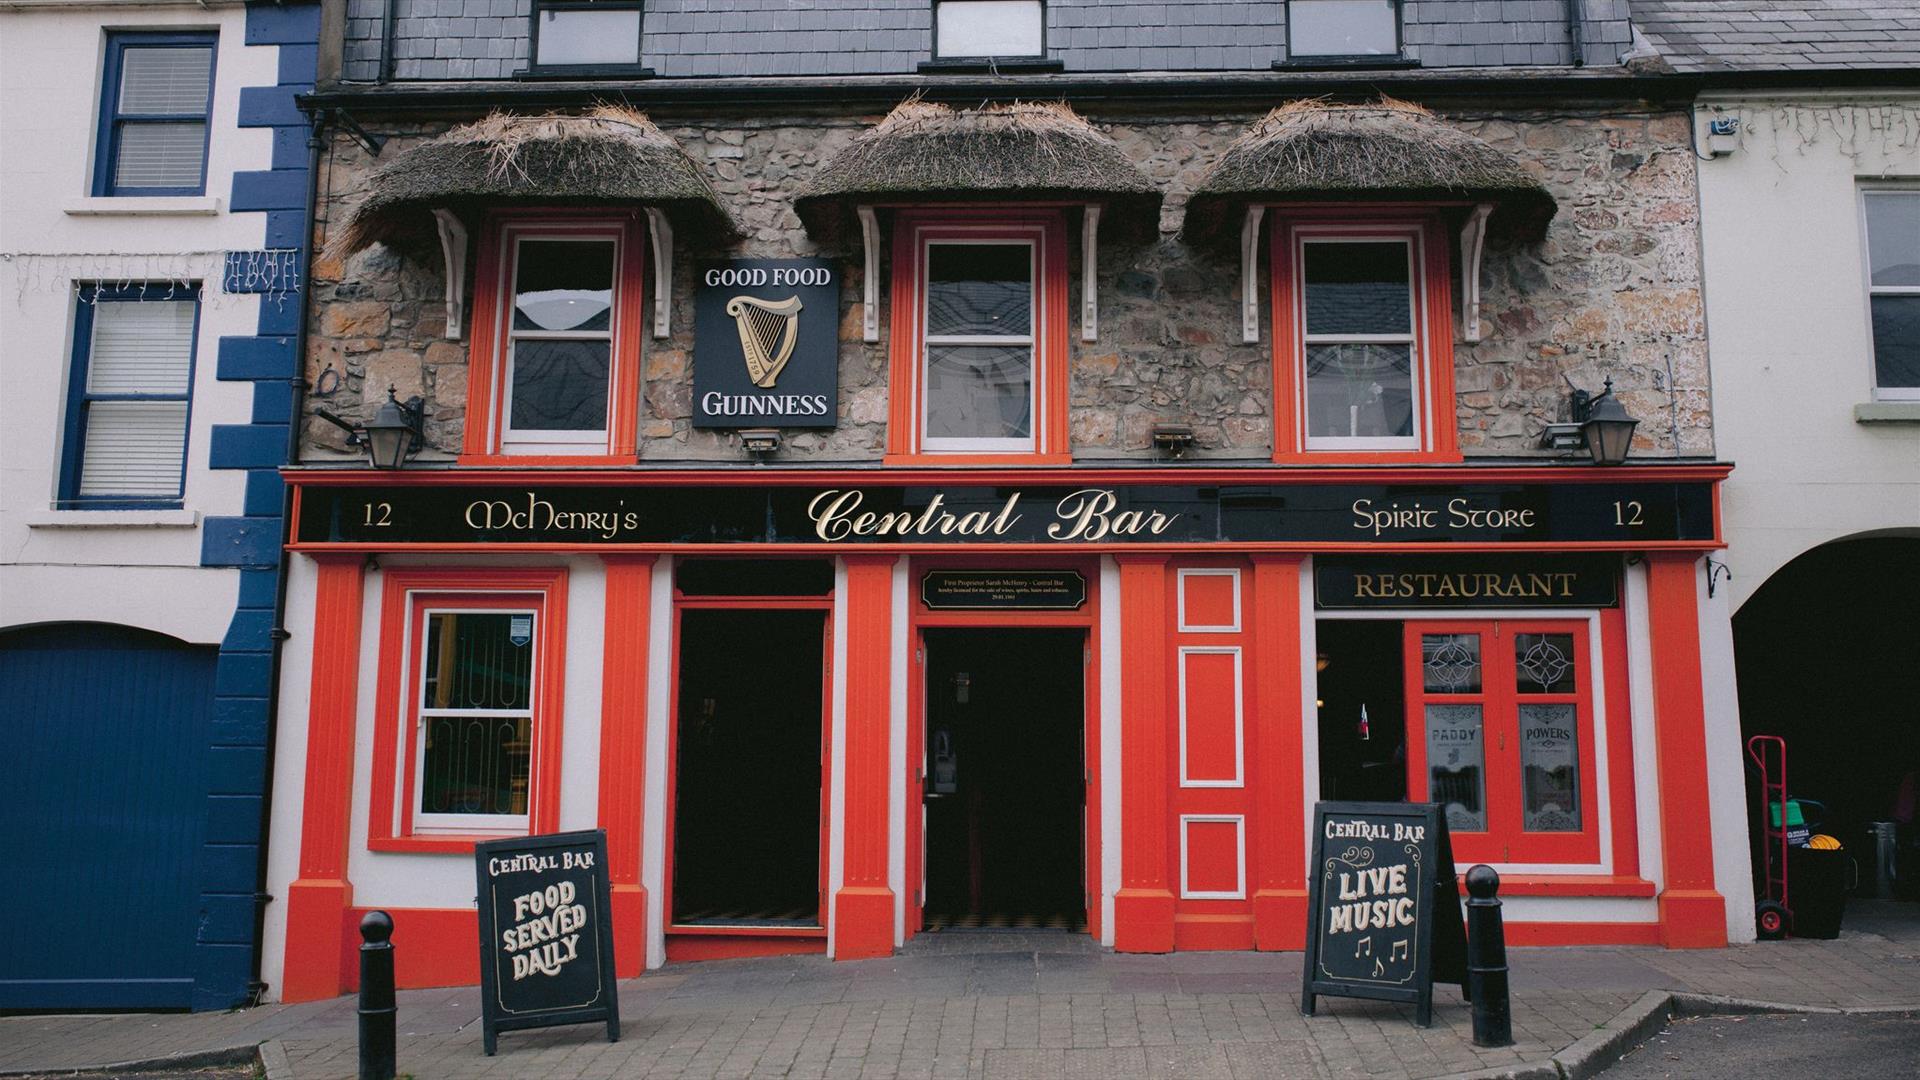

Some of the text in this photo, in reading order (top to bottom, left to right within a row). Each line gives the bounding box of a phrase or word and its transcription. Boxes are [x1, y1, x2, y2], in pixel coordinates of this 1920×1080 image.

[705, 268, 831, 286] GOOD FOOD
[702, 391, 828, 416] GUINNESS
[364, 502, 392, 527] 12
[465, 492, 638, 539] McHenry's
[807, 489, 1180, 542] Central Bar
[1352, 498, 1536, 536] Spirit Store
[1614, 501, 1644, 526] 12
[1354, 573, 1577, 598] RESTAURANT
[1432, 729, 1476, 741] PADDY
[1526, 727, 1570, 741] POWERS
[1325, 819, 1425, 843] CENTRAL BAR
[489, 851, 595, 877] CENTRAL BAR
[1338, 864, 1408, 900] LIVE
[513, 881, 576, 921] FOOD
[503, 904, 587, 953] SERVED
[1329, 897, 1415, 935] MUSIC
[512, 934, 580, 981] DAILY
